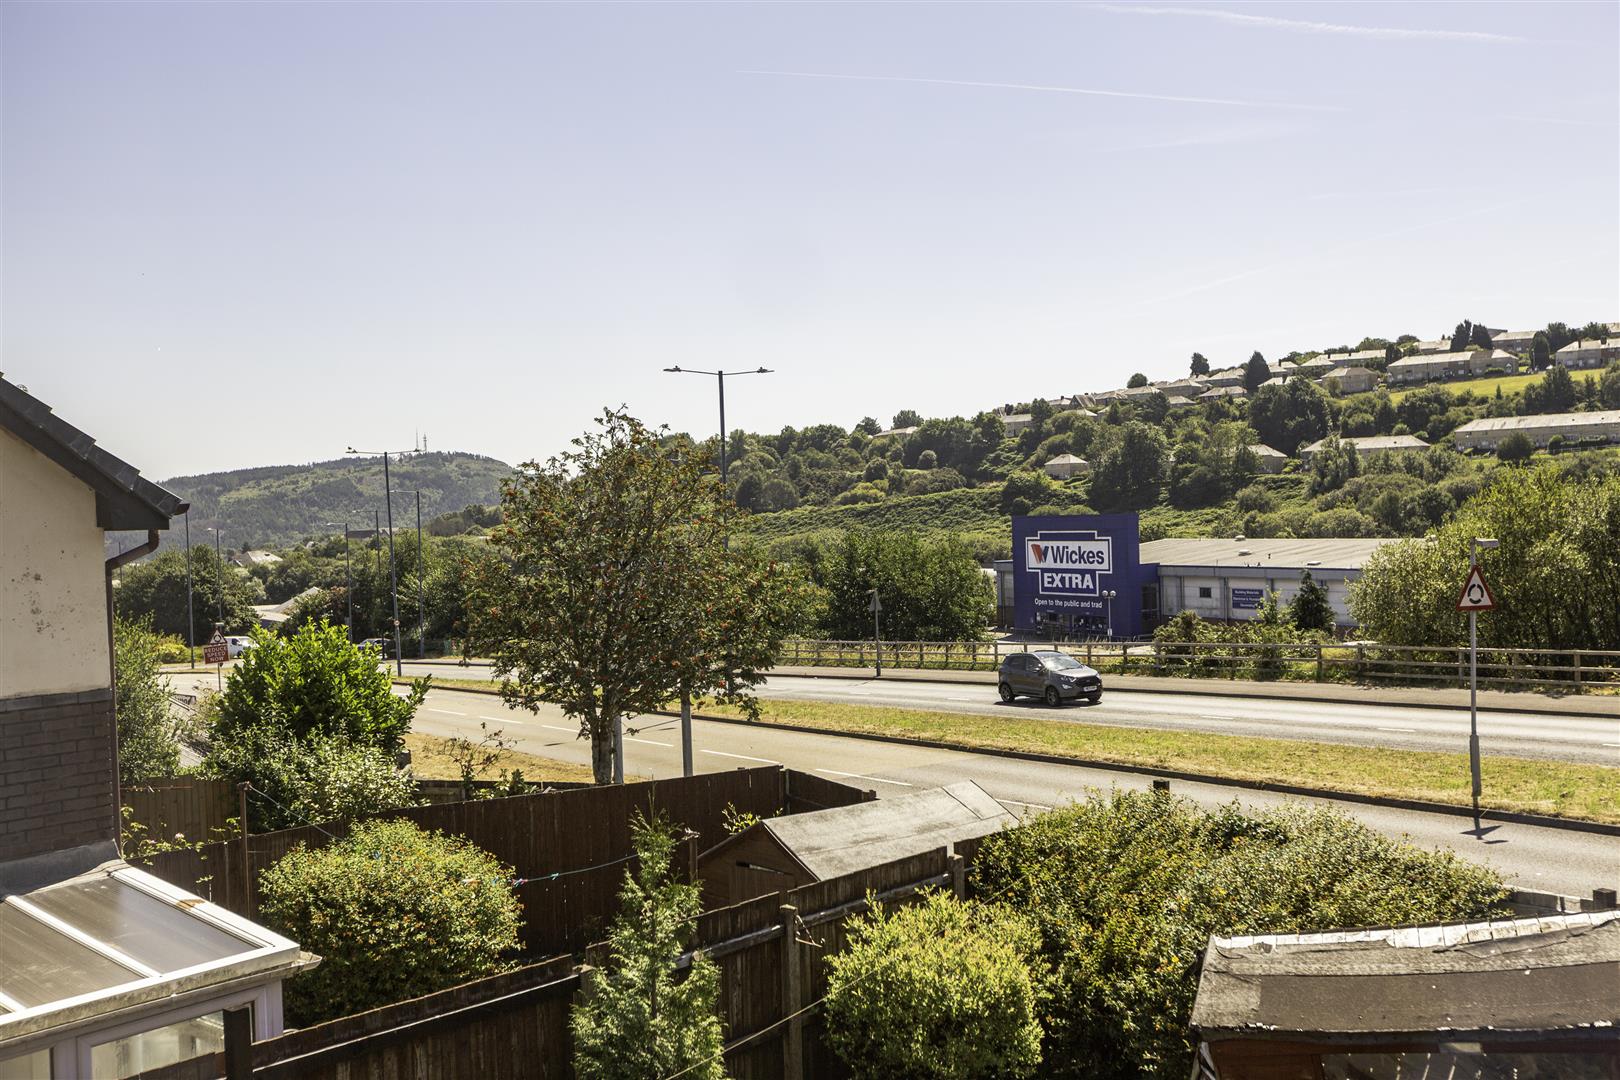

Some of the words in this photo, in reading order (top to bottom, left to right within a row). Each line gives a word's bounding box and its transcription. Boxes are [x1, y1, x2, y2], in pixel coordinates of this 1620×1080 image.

[1051, 545, 1105, 565] Wickes
[1043, 572, 1094, 589] EXTRA
[1034, 598, 1048, 606] Open
